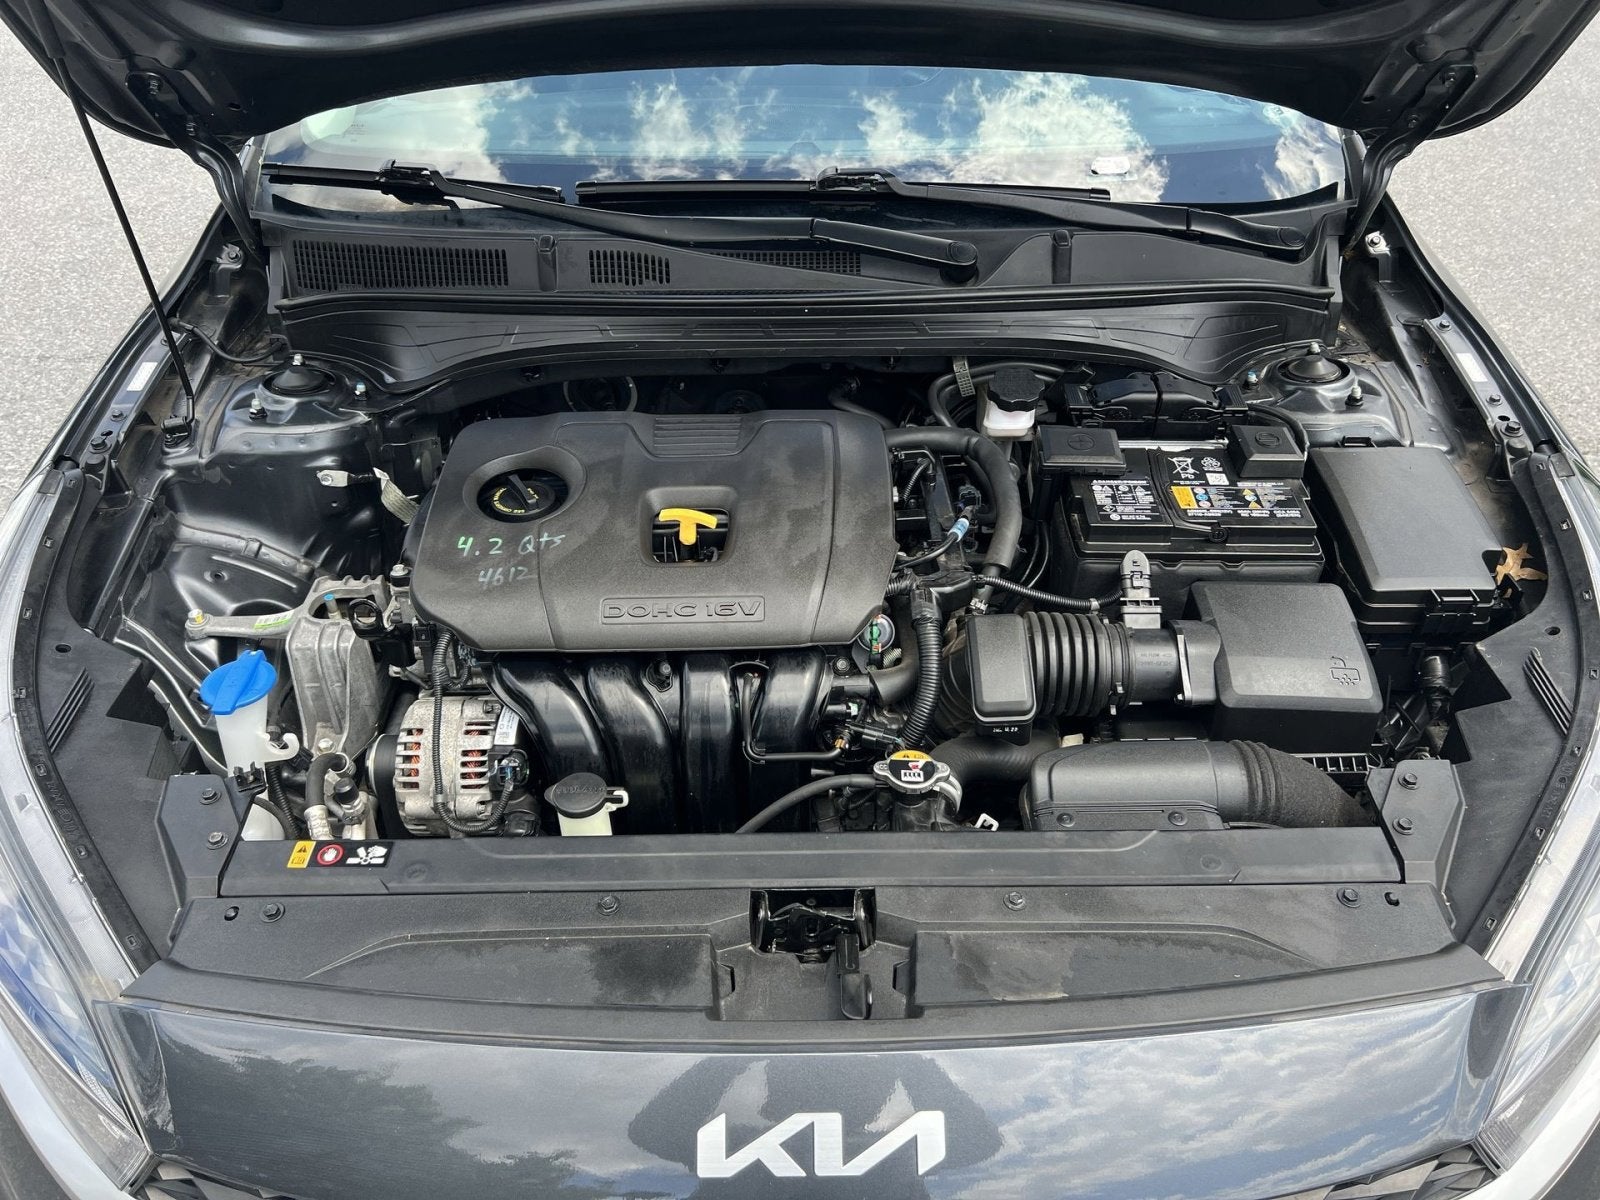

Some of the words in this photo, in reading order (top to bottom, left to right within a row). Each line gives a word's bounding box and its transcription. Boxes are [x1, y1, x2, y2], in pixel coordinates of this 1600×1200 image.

[457, 536, 503, 556] 4.2
[478, 566, 538, 590] 4612
[603, 603, 698, 619] DOHC
[706, 601, 761, 617] 16V
[696, 1110, 946, 1178] KIA
